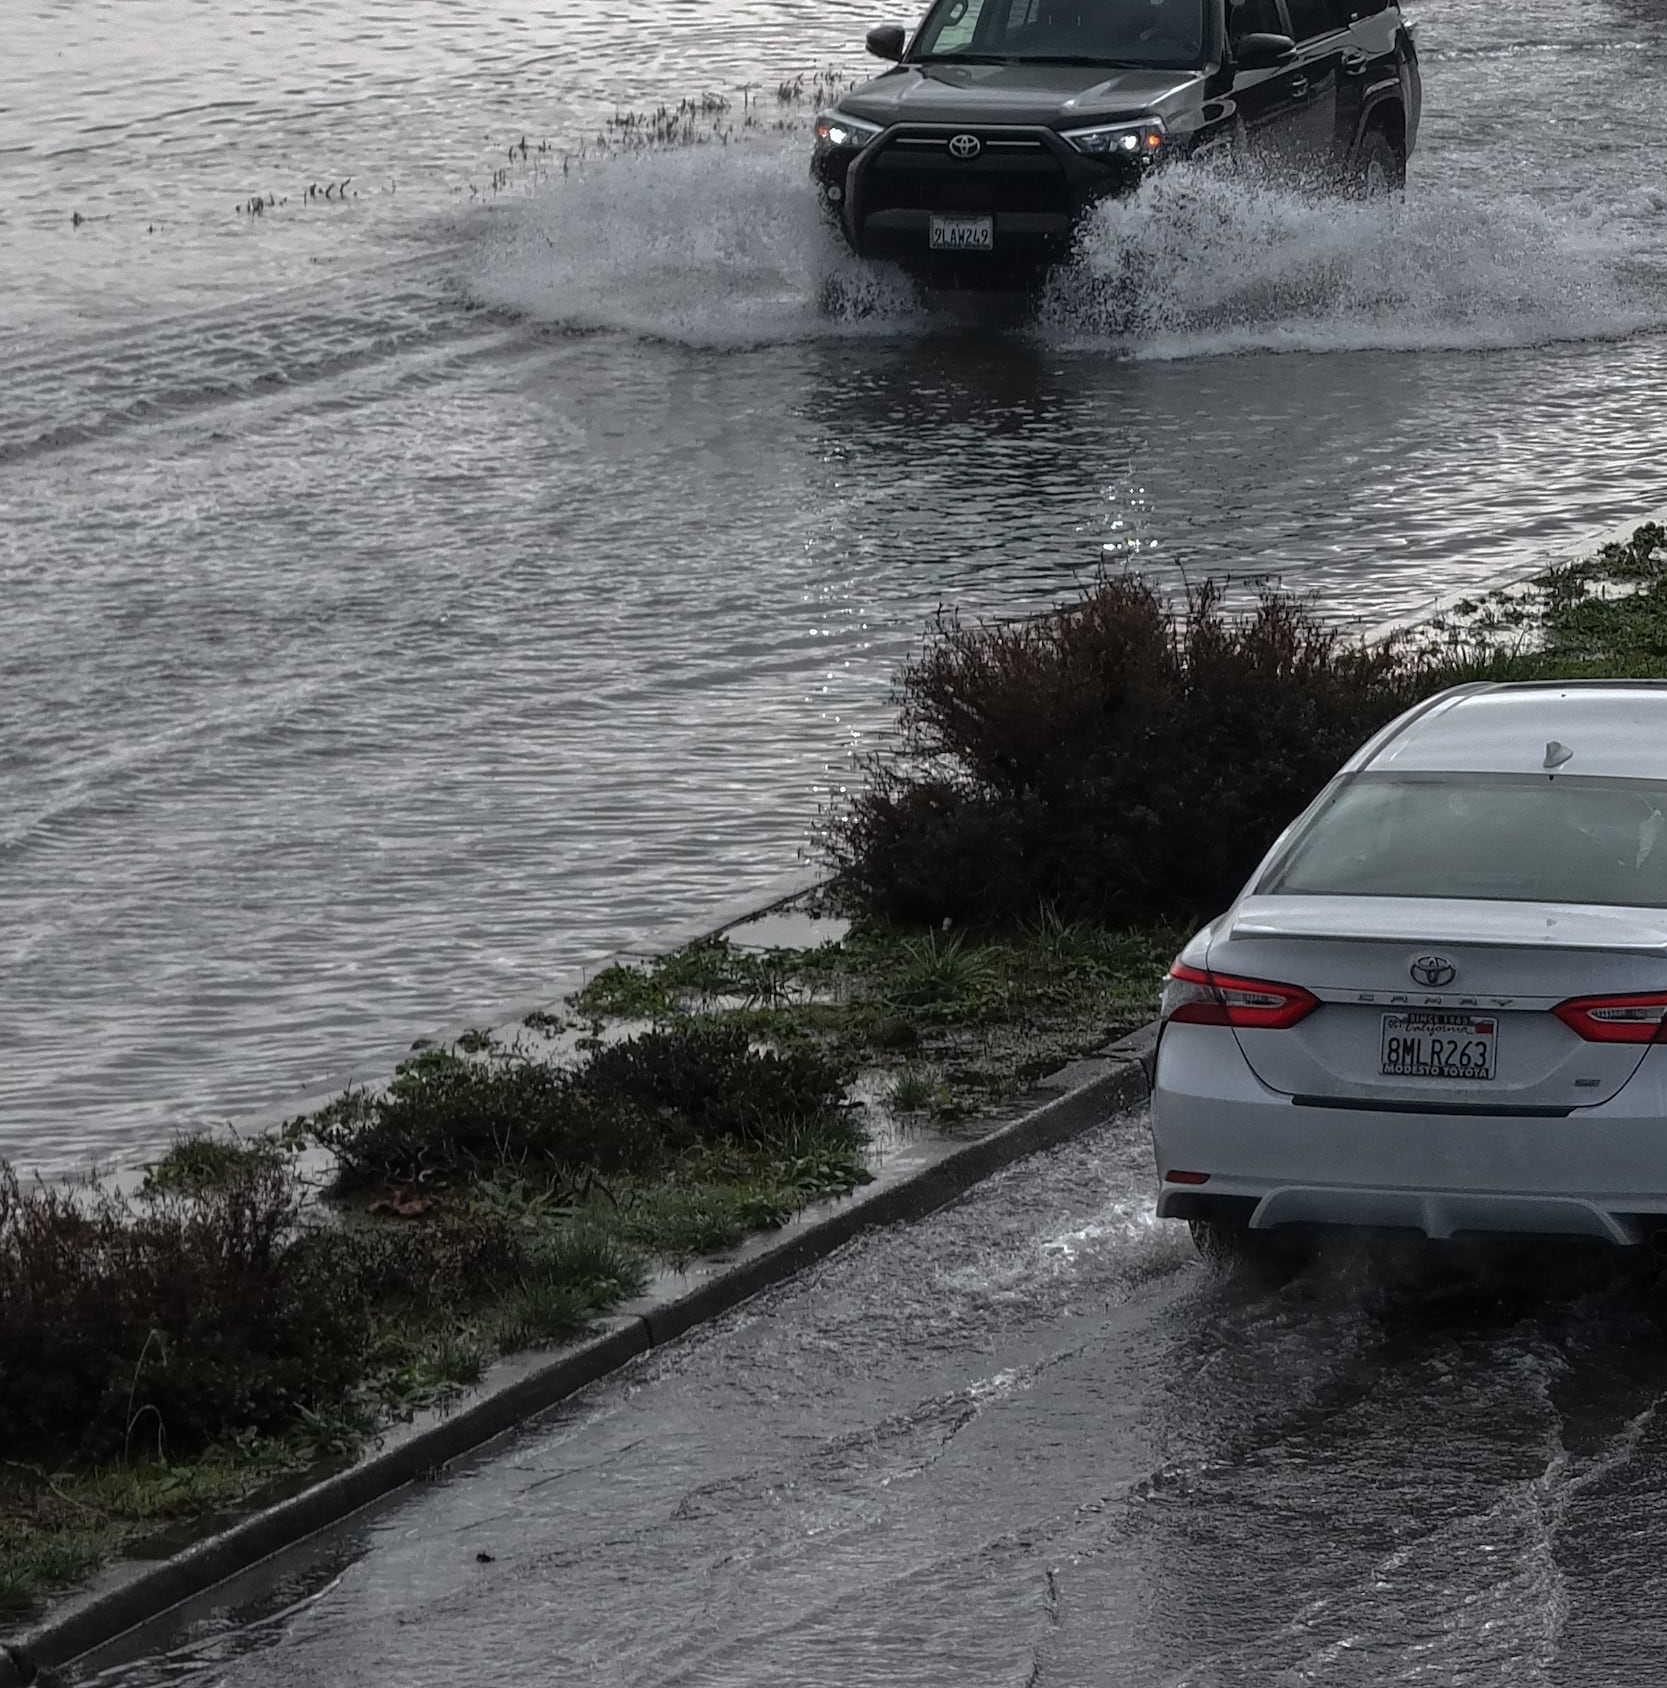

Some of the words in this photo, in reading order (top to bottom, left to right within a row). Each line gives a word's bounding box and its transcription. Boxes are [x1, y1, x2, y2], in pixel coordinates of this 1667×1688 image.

[1387, 1036, 1488, 1068] 8MLR263
[1383, 1064, 1440, 1076] MODESTO
[1442, 1066, 1488, 1078] TOYOTA
